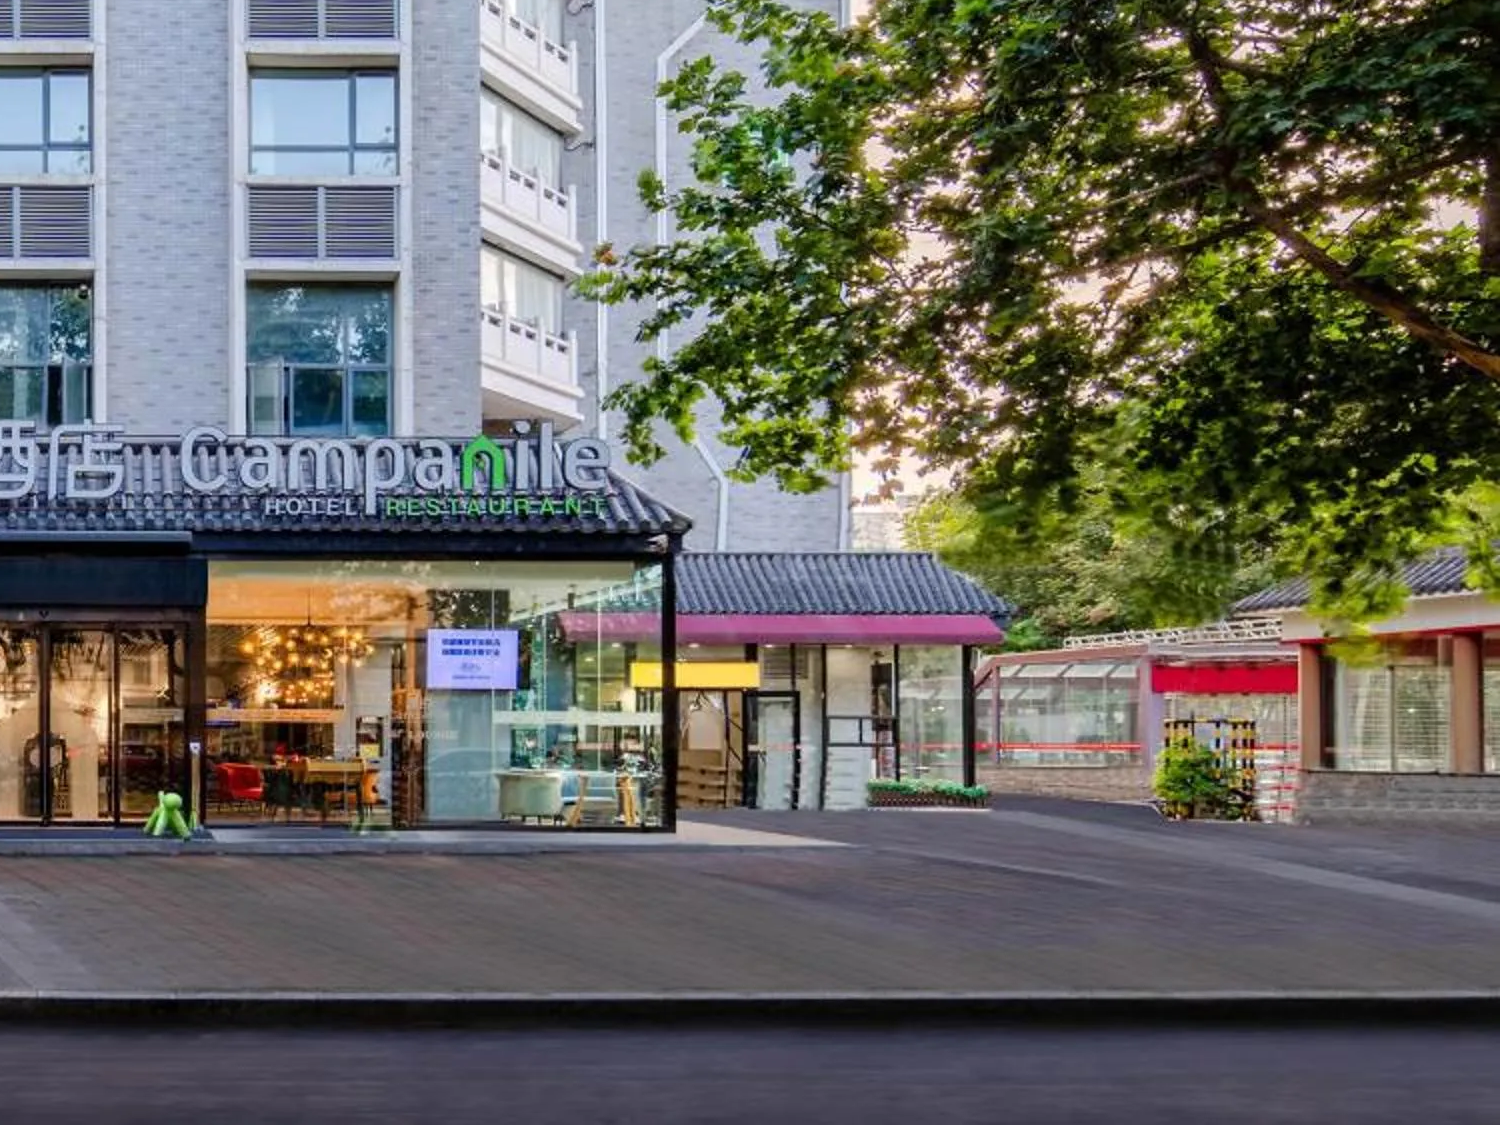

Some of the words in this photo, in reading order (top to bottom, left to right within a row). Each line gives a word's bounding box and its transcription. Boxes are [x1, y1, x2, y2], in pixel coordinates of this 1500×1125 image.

[180, 420, 612, 515] Campanile
[264, 497, 360, 517] HOTEL
[387, 496, 609, 517] RESTAURANT
